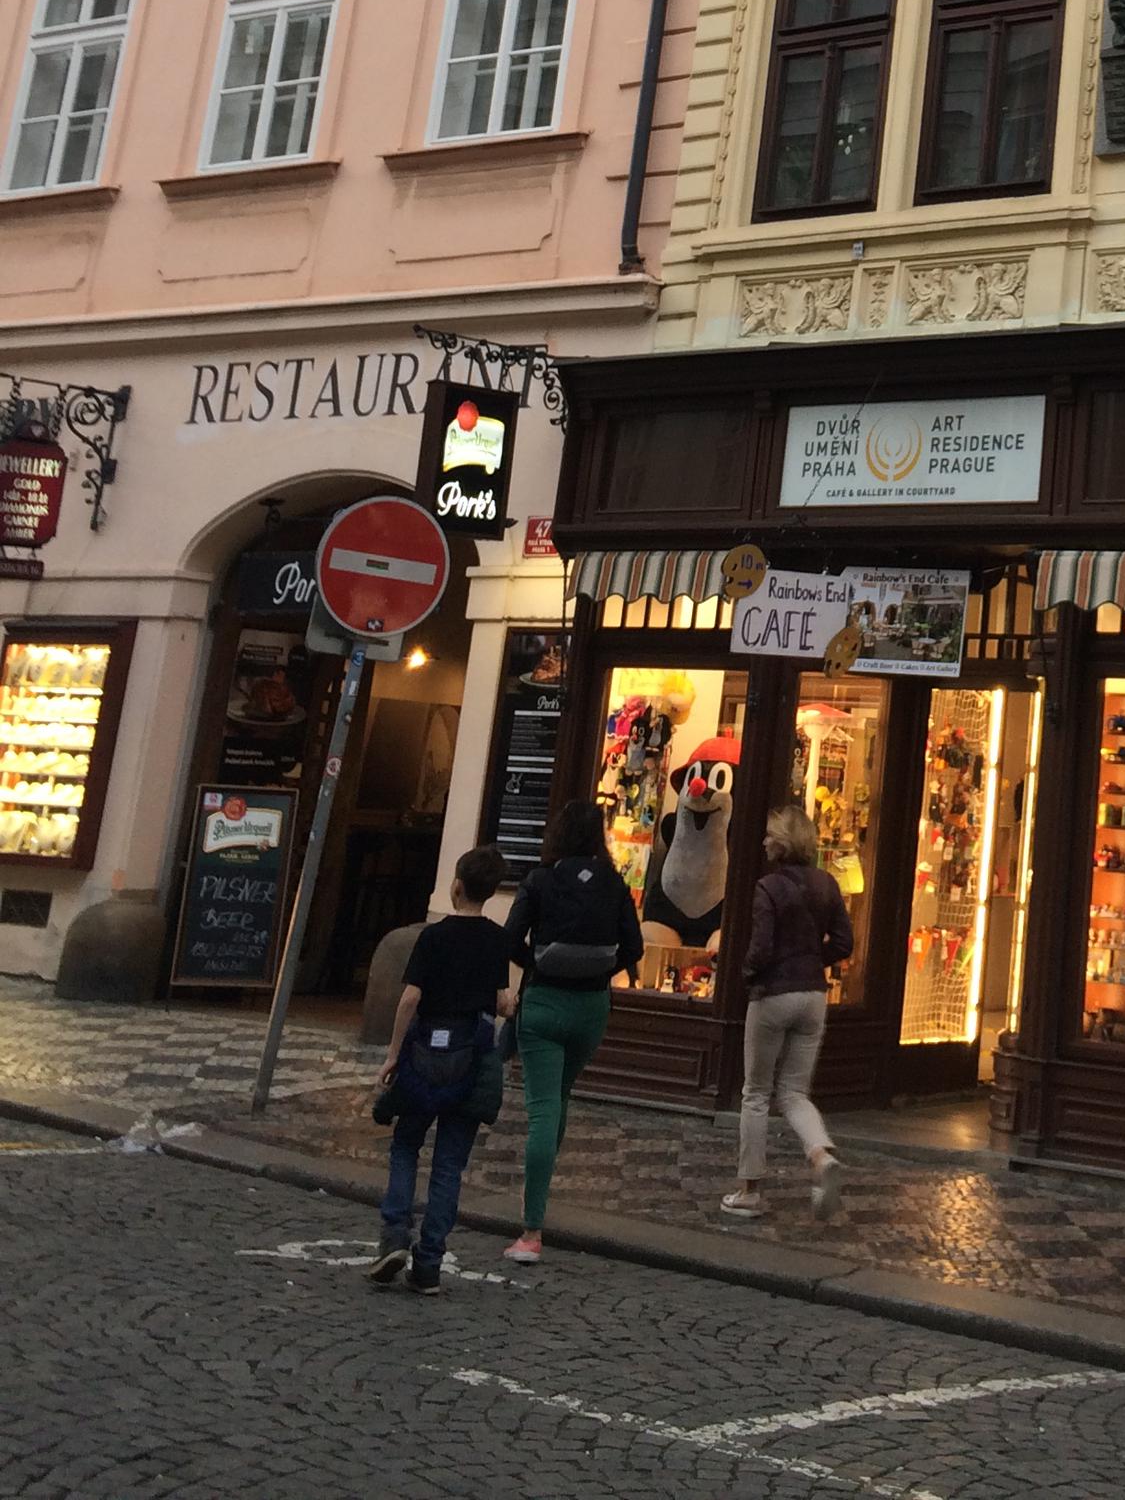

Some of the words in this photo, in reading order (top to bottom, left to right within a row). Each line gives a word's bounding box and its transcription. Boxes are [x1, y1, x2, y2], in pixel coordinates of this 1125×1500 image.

[816, 413, 861, 436] DVŮR
[931, 415, 965, 432] ART
[804, 436, 859, 457] UMĚNÍ
[930, 433, 1025, 453] RESIDENCE
[801, 460, 857, 478] PRAHA
[928, 456, 996, 474] PRAGUE
[437, 481, 497, 520] Pork's
[826, 487, 847, 498] CAFÉ
[856, 488, 893, 497] GALLERY
[895, 488, 903, 496] IN
[906, 487, 956, 496] COURTYARD
[535, 520, 552, 538] 47
[863, 572, 906, 584] Rainbow's
[909, 575, 926, 585] End
[825, 581, 847, 603] End
[741, 606, 817, 651] CAFÉ
[200, 875, 275, 902] PILSNER
